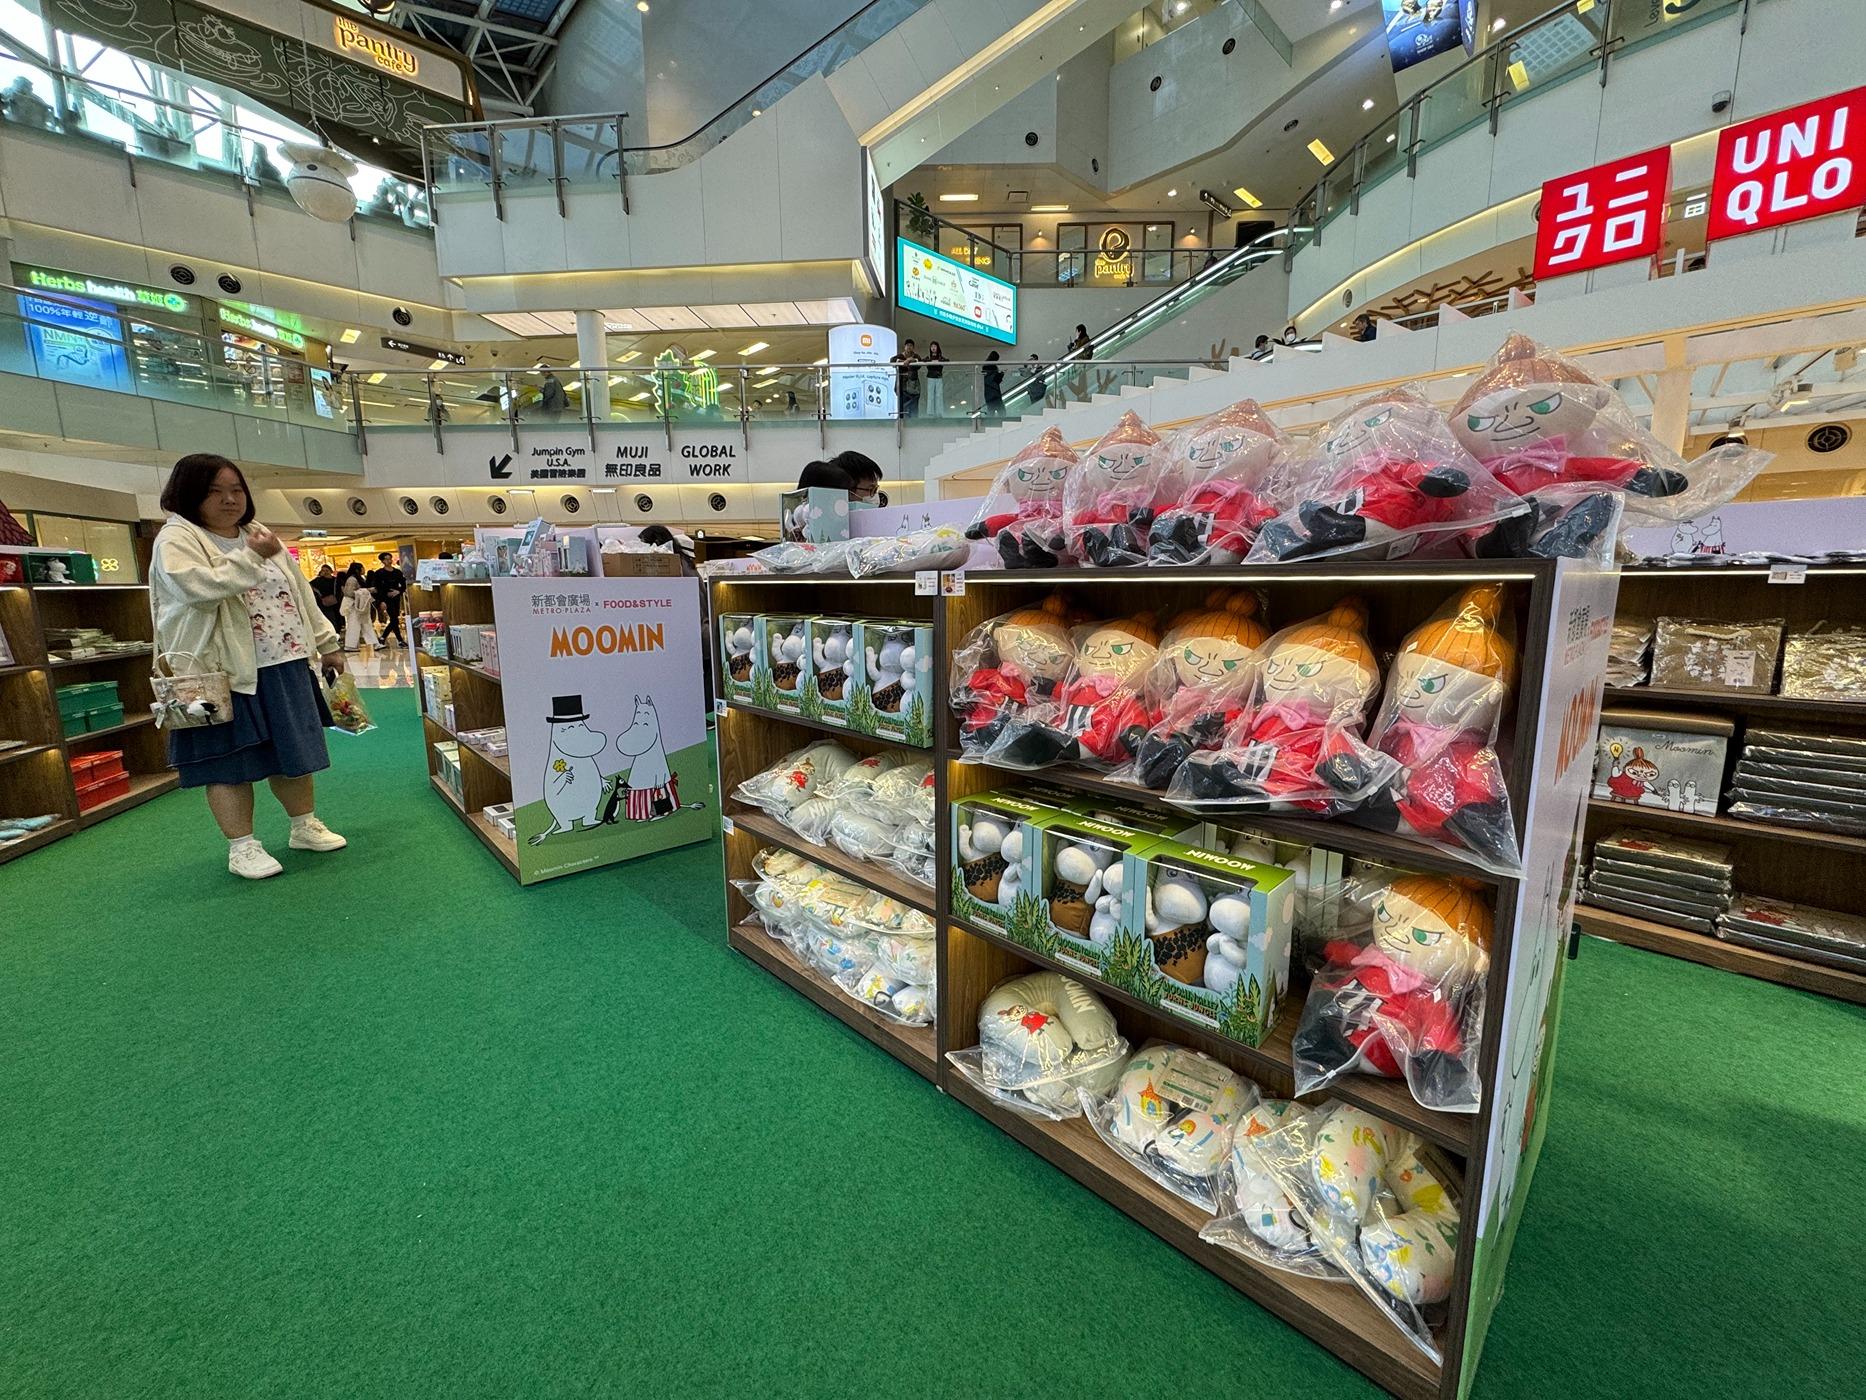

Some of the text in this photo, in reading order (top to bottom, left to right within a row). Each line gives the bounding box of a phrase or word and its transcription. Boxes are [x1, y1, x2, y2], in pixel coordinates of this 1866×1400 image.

[339, 27, 416, 73] pantry
[1731, 106, 1849, 174] UNI
[1556, 165, 1649, 222] ユニ
[1726, 157, 1853, 225] QLO
[1548, 209, 1647, 266] クロ
[30, 271, 85, 293] Herbs
[85, 279, 137, 302] health
[531, 447, 585, 457] Jumpin Gym
[616, 446, 649, 459] MUJI
[681, 445, 736, 458] GLOBAL
[546, 458, 571, 467] U.S.A.
[604, 463, 662, 477] 無印良品
[689, 463, 731, 476] WORK
[531, 593, 591, 607] 新都會廣場
[603, 599, 672, 609] FOOD&STYLE
[550, 622, 665, 658] MOOMIN
[1655, 740, 1714, 756] Moomin
[1079, 820, 1136, 838] MOOMIN
[1187, 849, 1257, 871] MOOMIN
